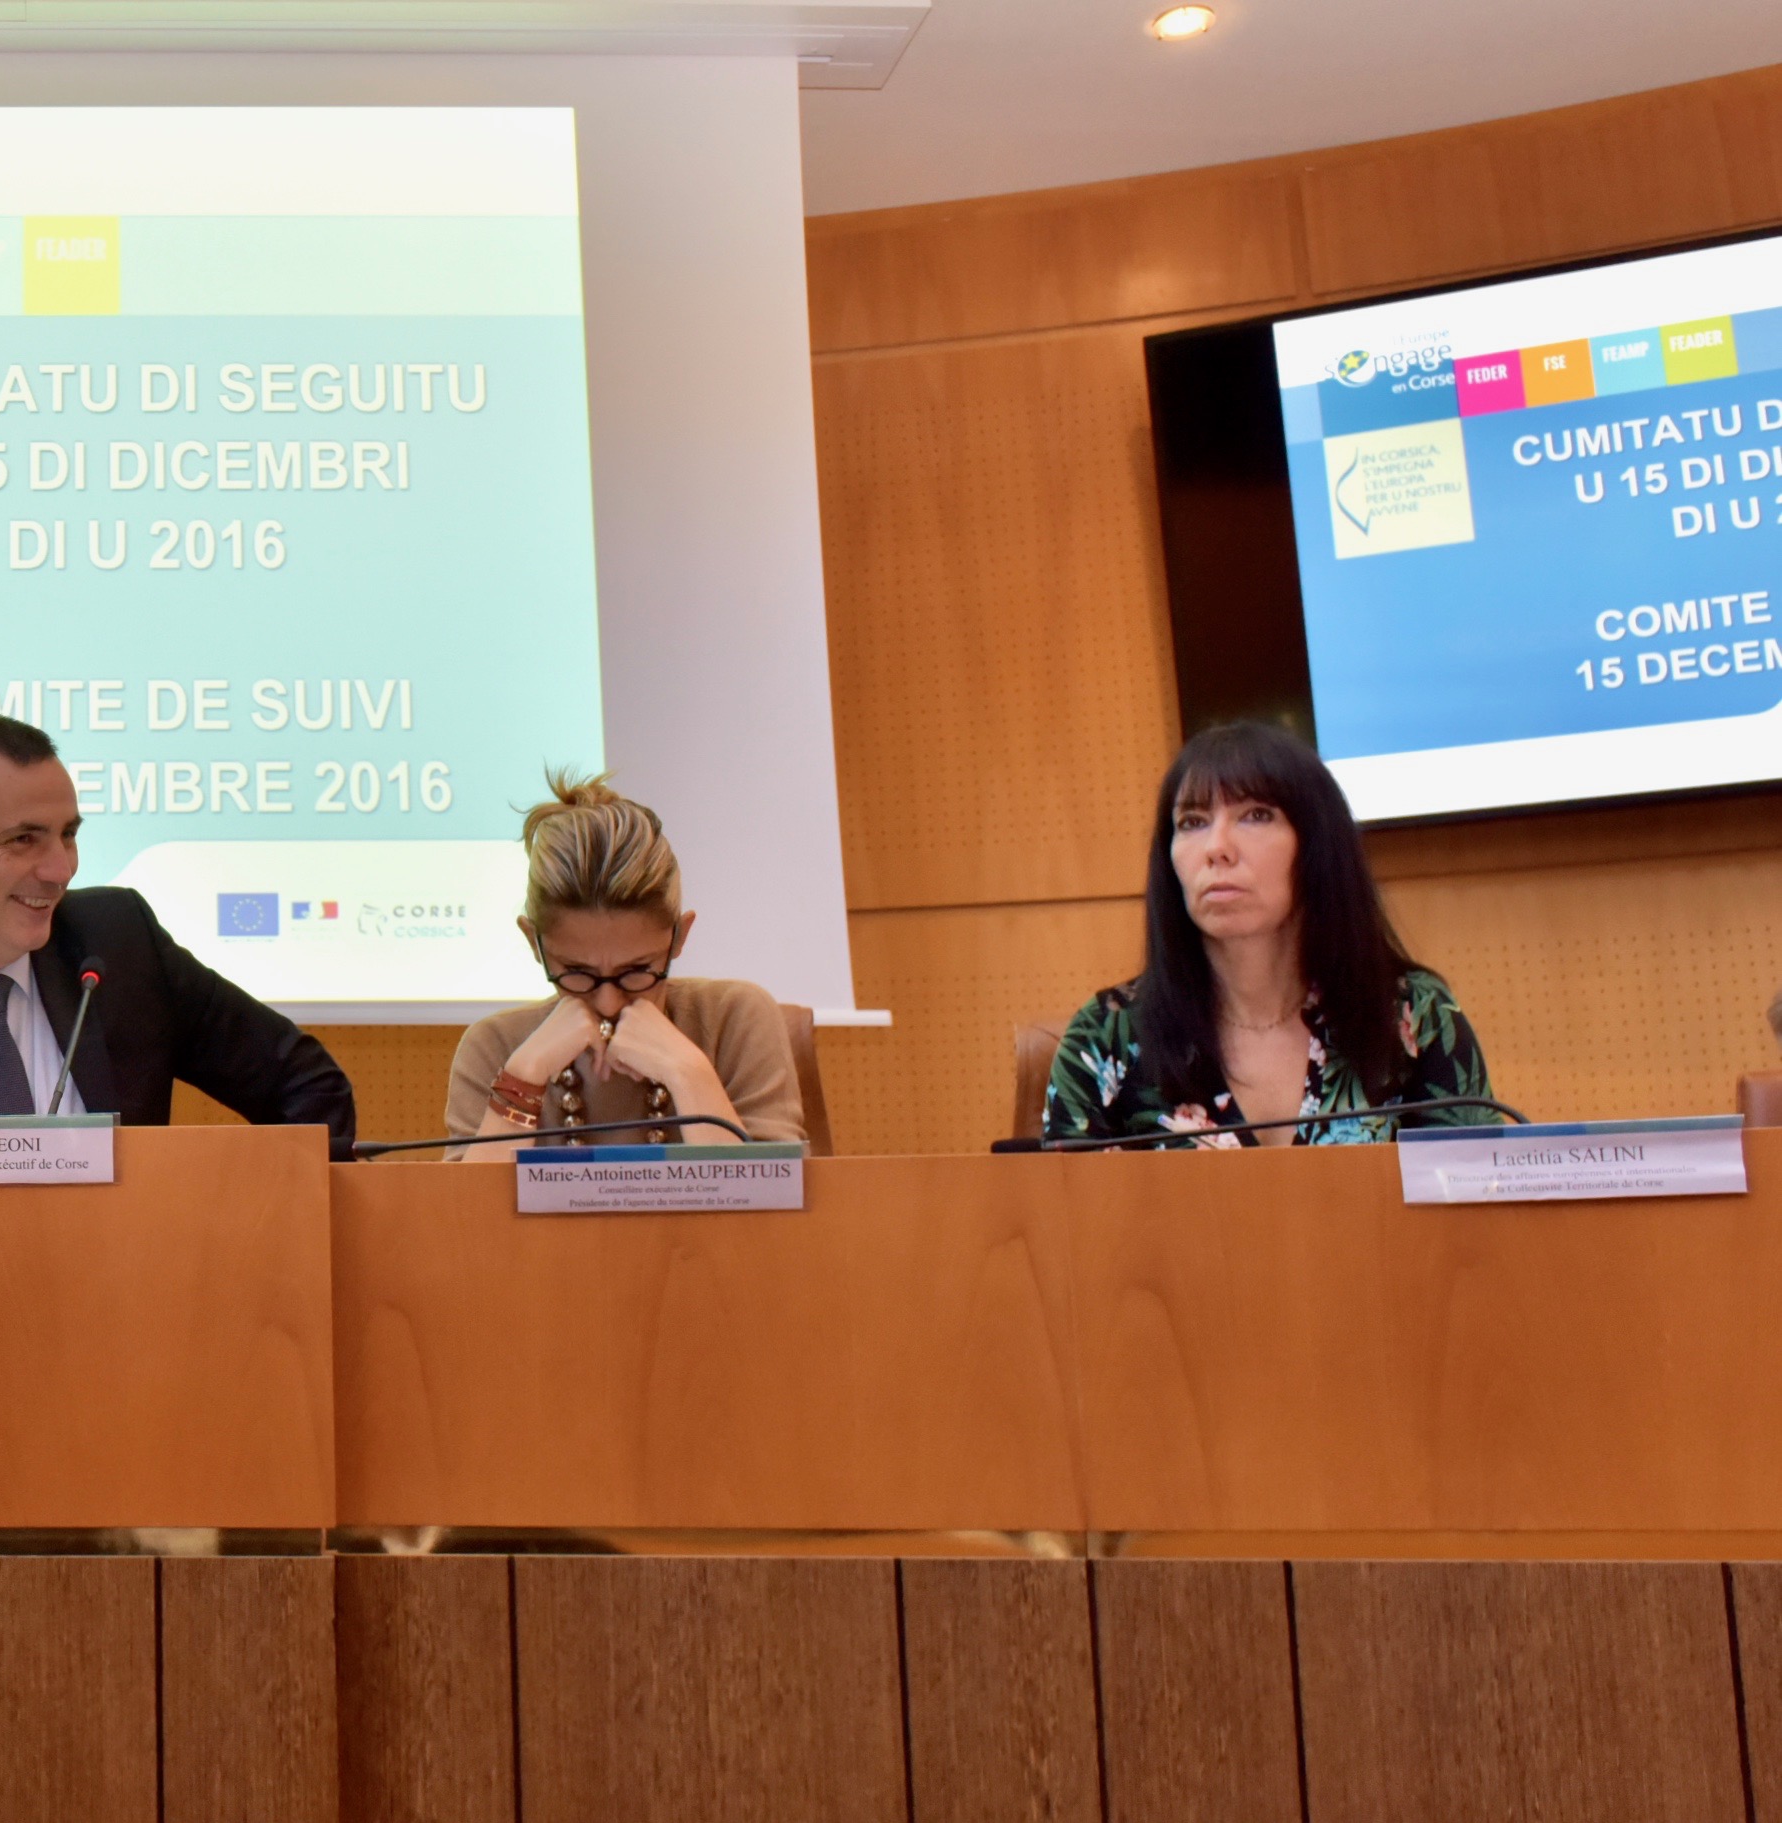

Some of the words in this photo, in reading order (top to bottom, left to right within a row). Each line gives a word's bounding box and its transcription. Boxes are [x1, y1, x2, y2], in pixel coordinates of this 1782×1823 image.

[35, 238, 106, 261] FEADER
[1467, 364, 1508, 385] FEDER
[1543, 355, 1566, 371] FSE
[1602, 341, 1649, 363] FEAMP
[1669, 330, 1723, 352] FEADER
[140, 364, 197, 412] DI
[218, 363, 487, 413] SEGUITU
[1392, 382, 1407, 393] en
[1408, 373, 1455, 390] Corse
[1513, 405, 1742, 466] CUMITATU
[29, 442, 86, 490] DI
[108, 441, 409, 490] DICEMBRI
[1362, 453, 1375, 464] IN
[1574, 472, 1605, 504] U
[1620, 463, 1669, 497] 15
[1680, 454, 1726, 489] DI
[1366, 490, 1388, 503] PER
[1392, 490, 1402, 501] U
[1406, 482, 1462, 499] NOSTRU
[1369, 501, 1419, 517] AVVENE
[1671, 503, 1717, 538] DI
[1730, 497, 1761, 530] U
[8, 520, 65, 570] DI
[88, 520, 126, 570] U
[149, 519, 287, 570] 2016
[1596, 591, 1772, 641] COMITE
[1576, 657, 1624, 691] 15
[147, 680, 230, 730] DE
[250, 679, 414, 731] SUIVI
[69, 762, 292, 813] EMBRE
[314, 760, 453, 813] 2016
[393, 905, 466, 918] CORSE
[394, 926, 466, 938] CORSICA
[39, 1158, 52, 1170] de
[55, 1158, 89, 1170] Corse
[1569, 1146, 1645, 1163] SALINI
[528, 1166, 661, 1183] Marie-Antoinette
[666, 1163, 791, 1180] MAUPERTUIS
[1496, 1172, 1513, 1182] des
[1515, 1170, 1550, 1181] affaires
[684, 1184, 694, 1193] de
[1566, 1179, 1618, 1191] Territoriale
[1621, 1178, 1633, 1189] de
[1635, 1178, 1664, 1188] Corse
